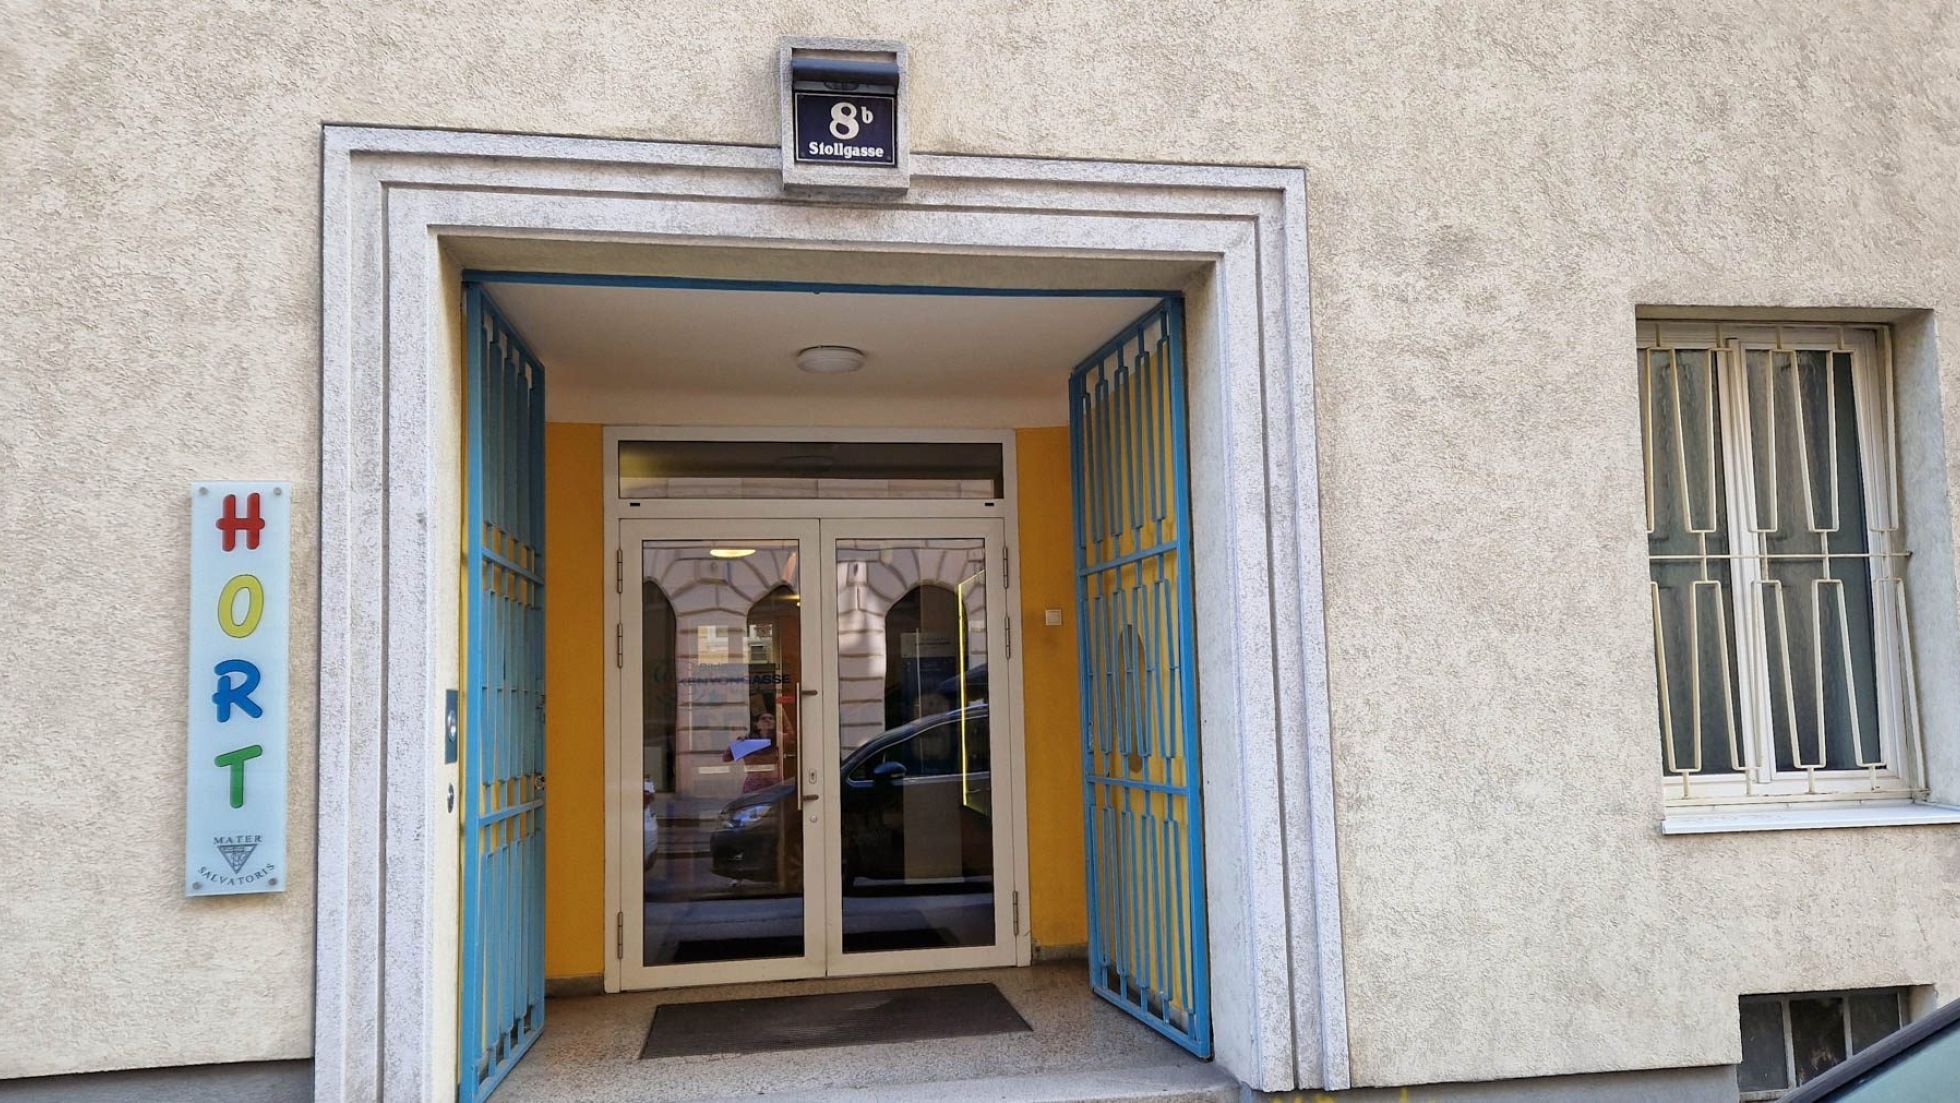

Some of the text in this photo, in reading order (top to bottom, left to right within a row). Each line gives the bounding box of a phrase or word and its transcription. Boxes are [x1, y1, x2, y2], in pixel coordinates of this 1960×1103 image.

[808, 141, 884, 159] Stollgasse
[211, 492, 266, 809] HORT
[213, 835, 263, 844] MATER
[198, 863, 275, 886] SALVATORIS
